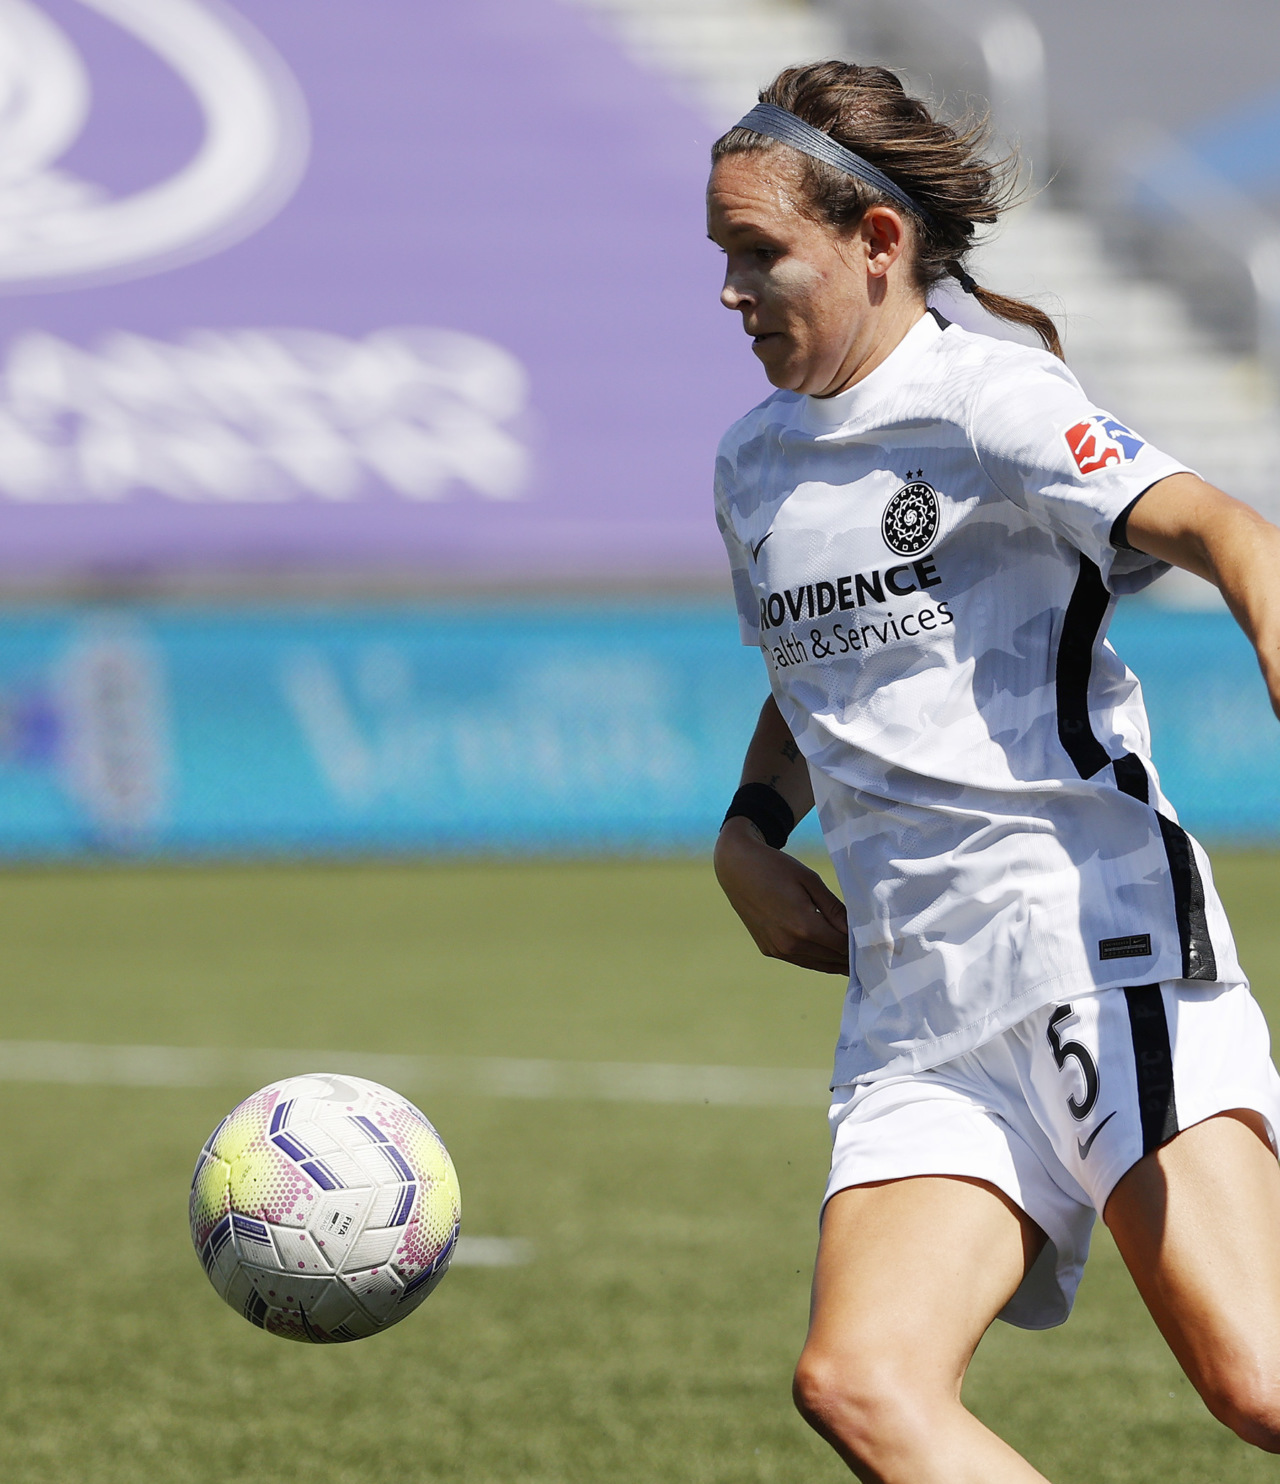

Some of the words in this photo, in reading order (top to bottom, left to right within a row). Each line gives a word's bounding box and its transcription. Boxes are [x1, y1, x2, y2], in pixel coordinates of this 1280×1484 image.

[888, 486, 935, 513] PORTLAND
[887, 523, 935, 551] THORNS
[760, 555, 942, 631] ROVIDENCE
[763, 632, 809, 671] alth
[811, 629, 836, 660] &
[833, 601, 954, 653] Services
[1047, 1001, 1100, 1122] 5
[338, 1216, 352, 1235] FIFA
